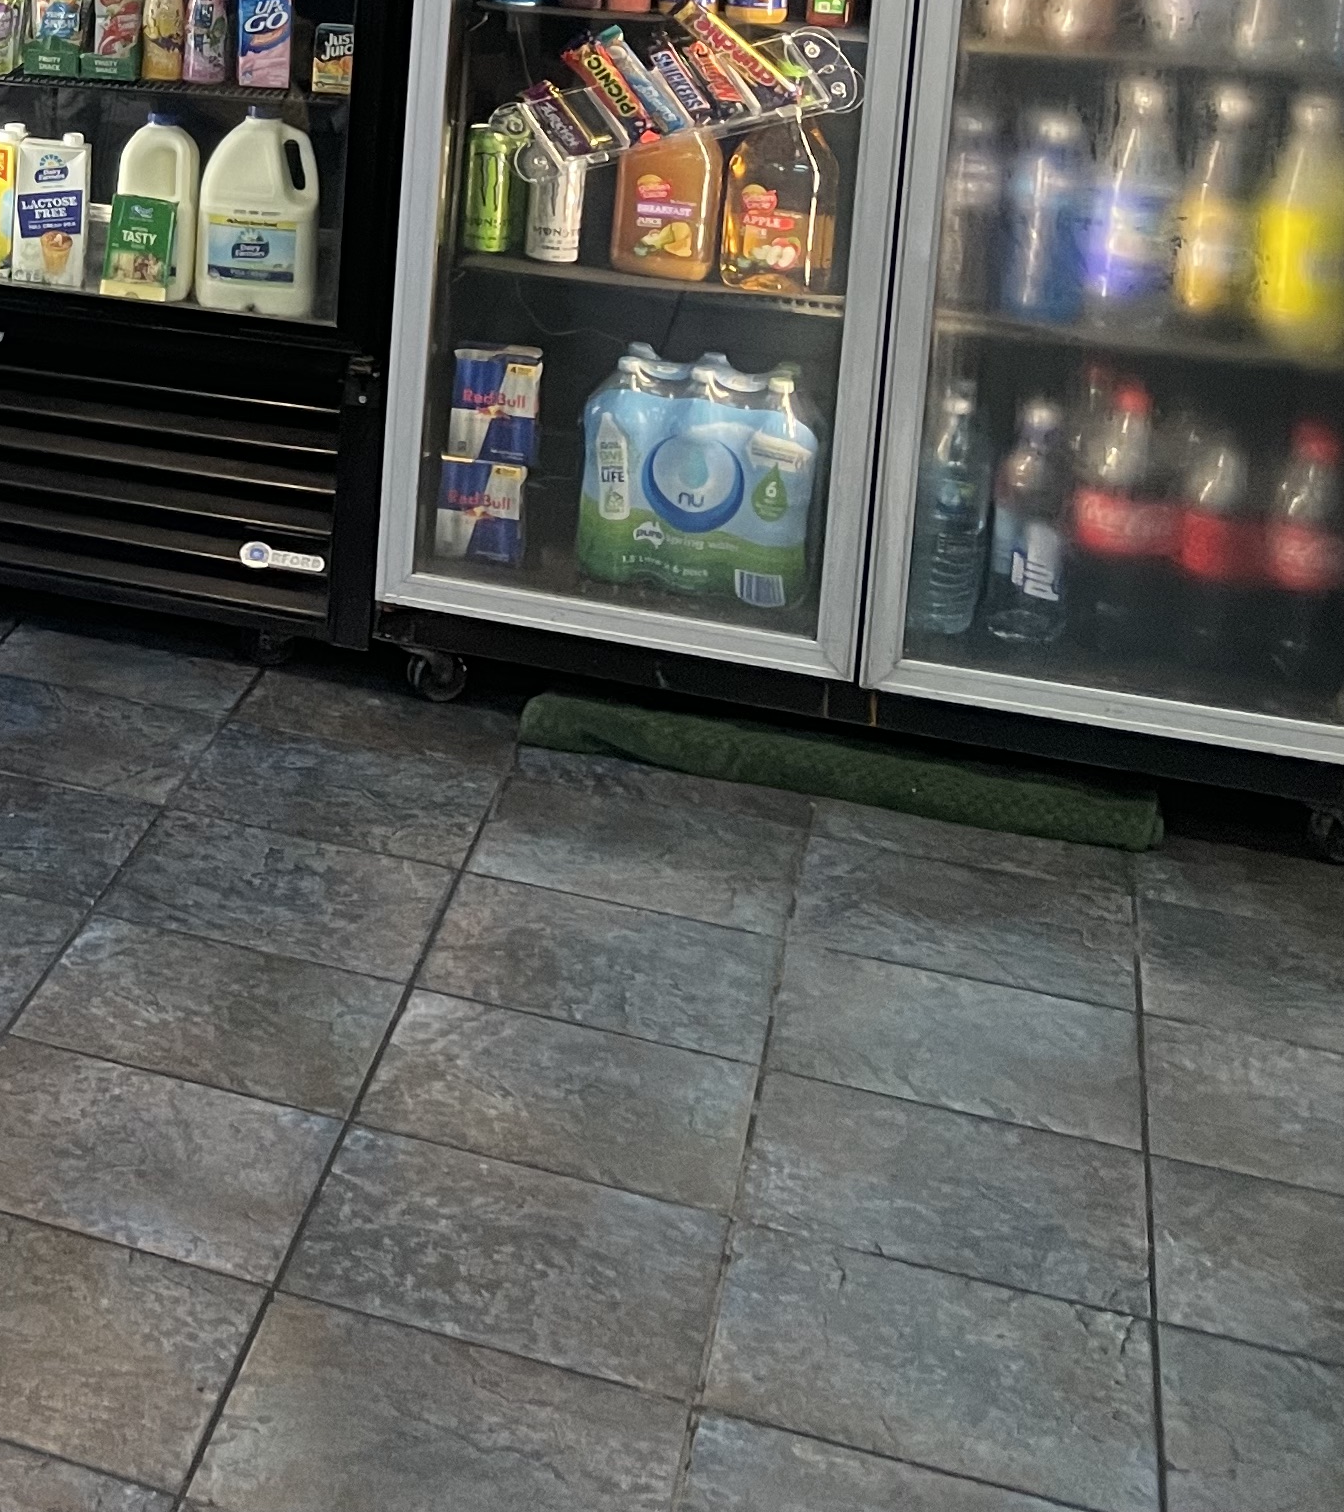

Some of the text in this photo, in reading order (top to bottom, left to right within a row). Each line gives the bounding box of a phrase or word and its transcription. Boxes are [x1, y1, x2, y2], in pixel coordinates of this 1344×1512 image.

[244, 11, 289, 32] GO
[585, 54, 639, 118] PICNIC
[653, 53, 704, 111] SNICKERS
[21, 196, 78, 210] LACTOSE
[637, 203, 692, 217] BREAKFAST
[34, 208, 67, 219] FREE
[743, 214, 781, 228] APPLE
[122, 229, 157, 246] TASTY
[463, 389, 526, 409] Red Bull
[601, 471, 625, 483] LIFE
[765, 481, 777, 498] 6
[447, 489, 511, 511] Red Bull
